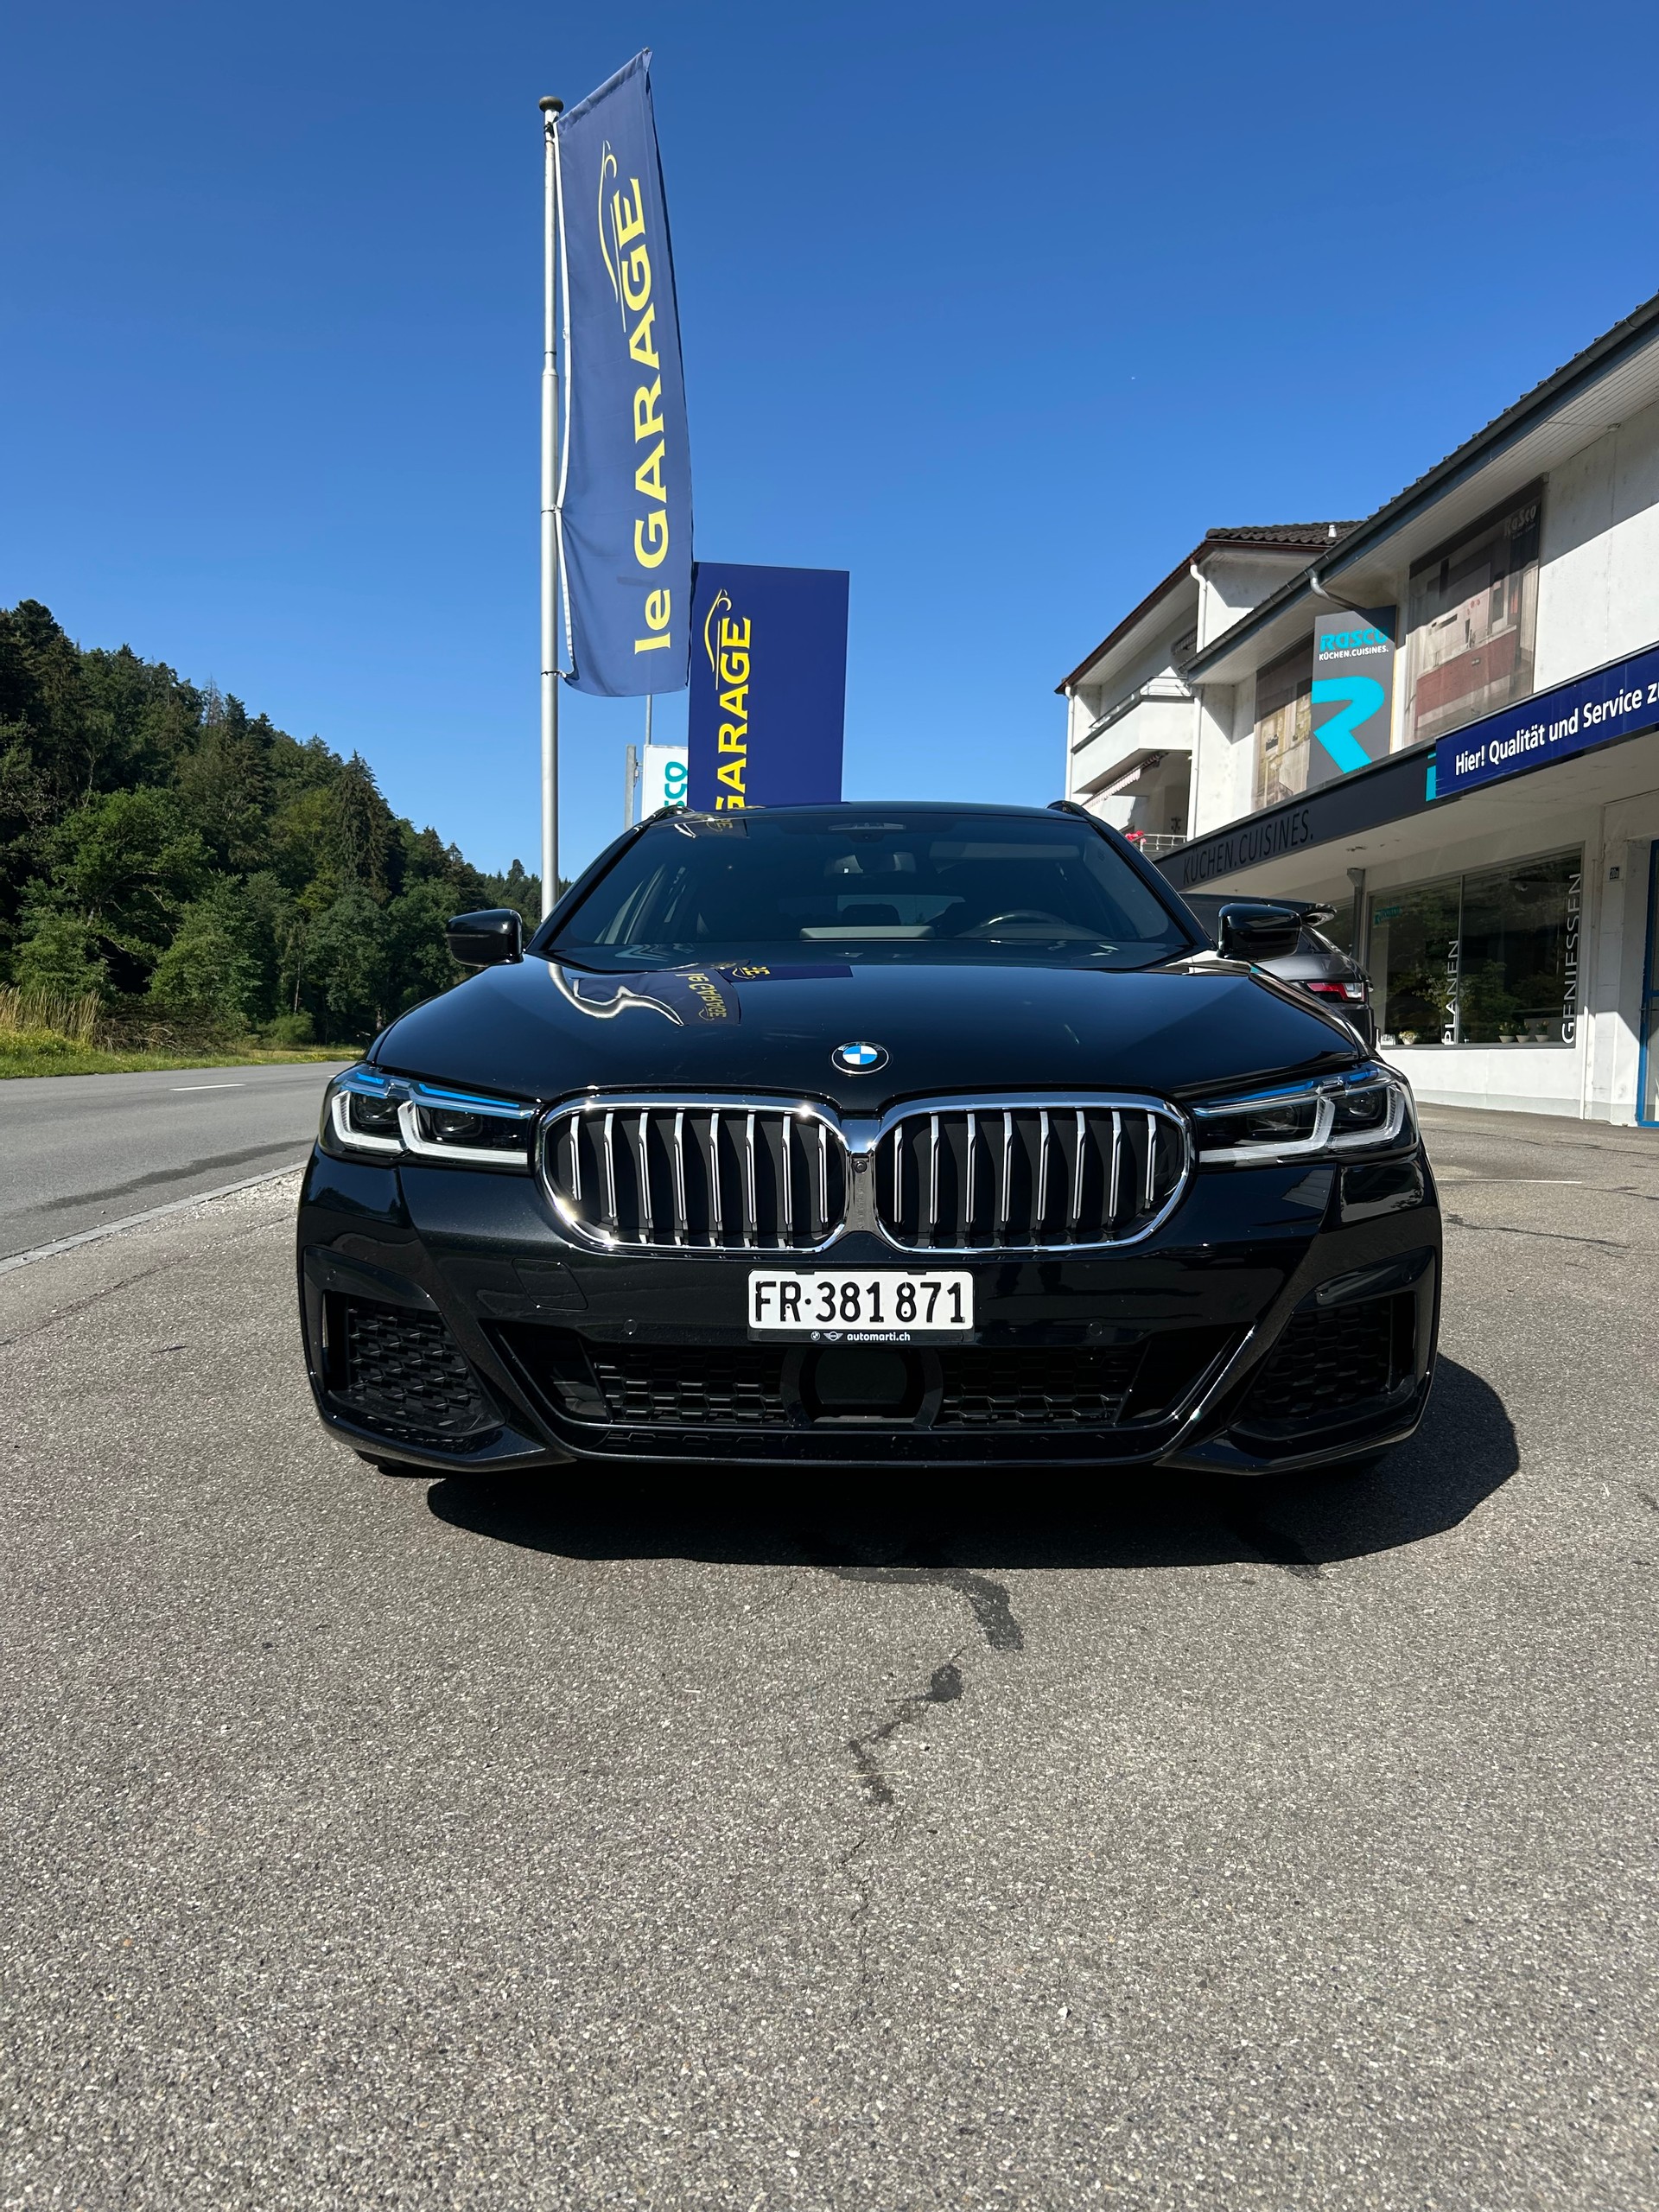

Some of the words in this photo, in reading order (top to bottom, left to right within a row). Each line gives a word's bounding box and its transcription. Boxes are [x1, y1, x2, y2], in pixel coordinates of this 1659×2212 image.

[613, 178, 670, 569] GARAGE
[635, 588, 671, 655] le
[1455, 745, 1485, 775] Hier!
[1489, 725, 1545, 765] Qualität
[1548, 708, 1579, 741] und
[1583, 689, 1643, 728] Service
[1647, 681, 1659, 704] z
[1183, 810, 1313, 886] KÜCHEN.CUISINES.
[1444, 940, 1459, 1046] PLANEN
[1561, 873, 1581, 1044] GENIESSEN
[847, 1332, 911, 1341] automarti.ch
[895, 1281, 966, 1323] 871
